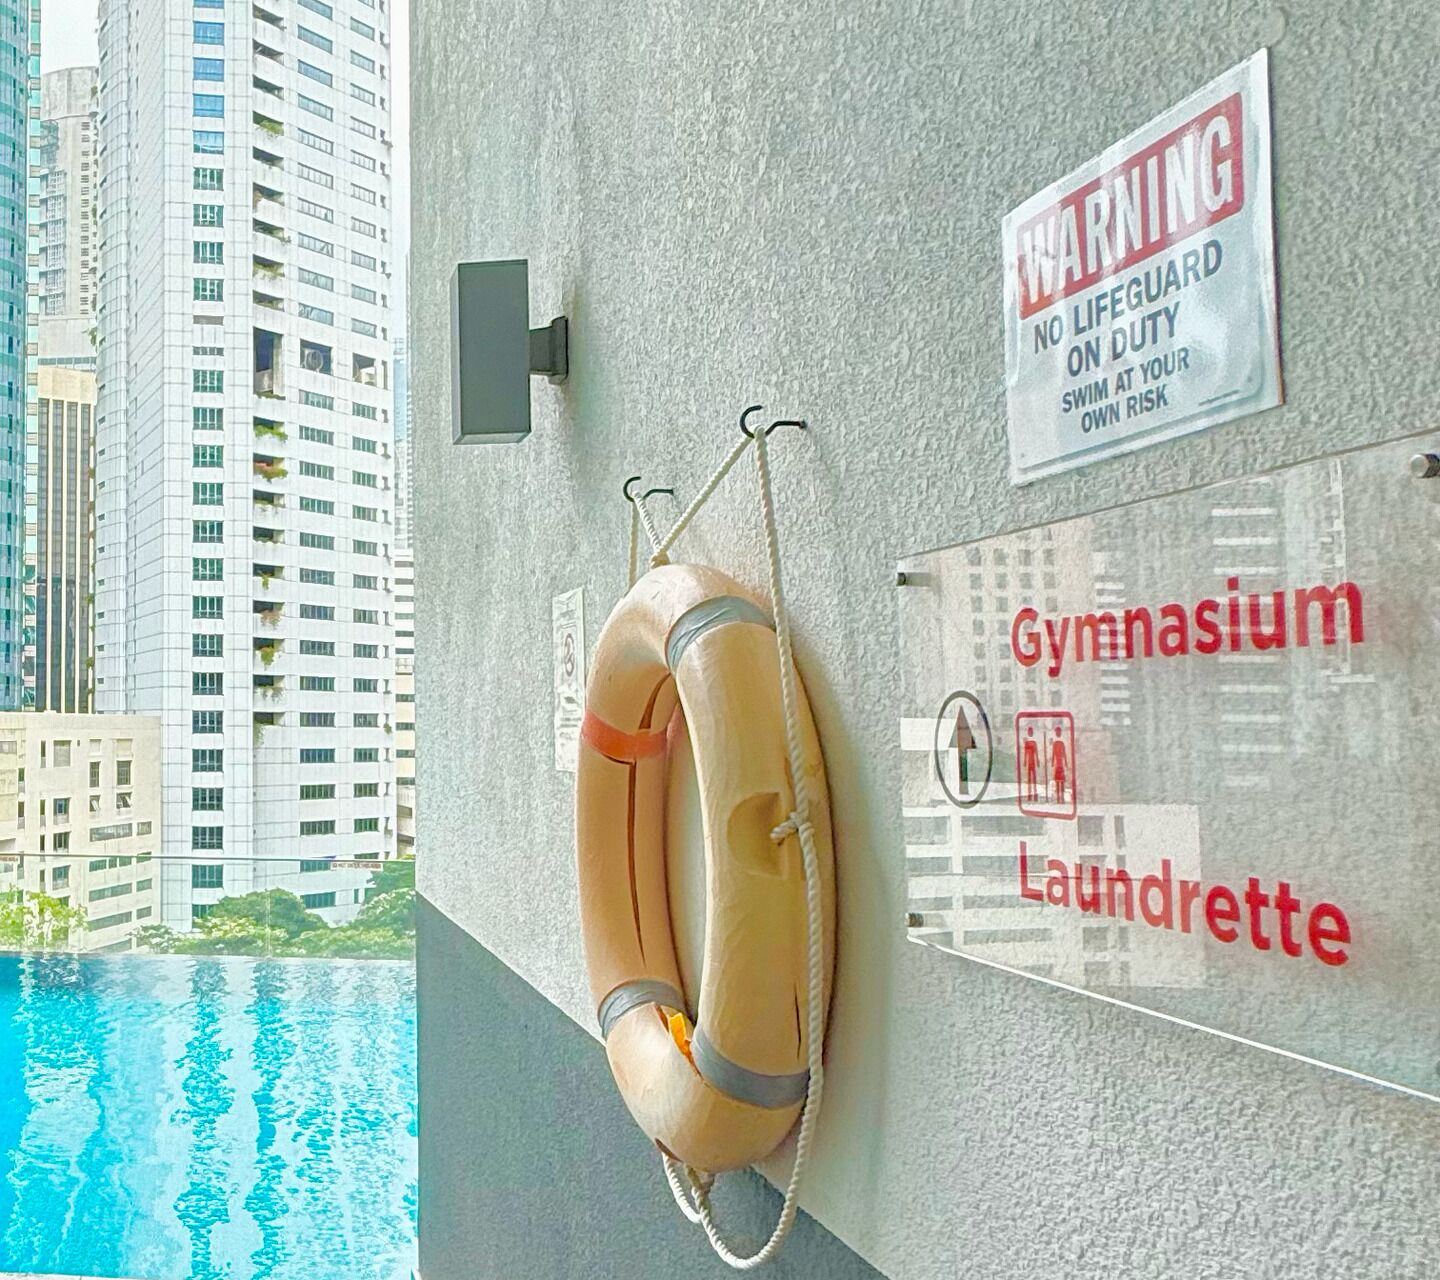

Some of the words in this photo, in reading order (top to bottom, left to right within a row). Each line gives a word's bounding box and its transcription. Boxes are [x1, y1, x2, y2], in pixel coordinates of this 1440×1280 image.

[1023, 115, 1233, 304] WARNING
[1034, 315, 1063, 354] NO
[1073, 239, 1223, 337] LIFEGUARD
[1067, 337, 1101, 377] ON
[1111, 301, 1180, 361] DUTY
[1062, 378, 1109, 413] SWIM
[1114, 367, 1135, 395] AT
[1139, 347, 1190, 384] YOUR
[1081, 402, 1121, 433] OWN
[1126, 384, 1169, 419] RISK
[1011, 576, 1365, 678] Gymnasium
[1019, 841, 1352, 966] Laundrette
